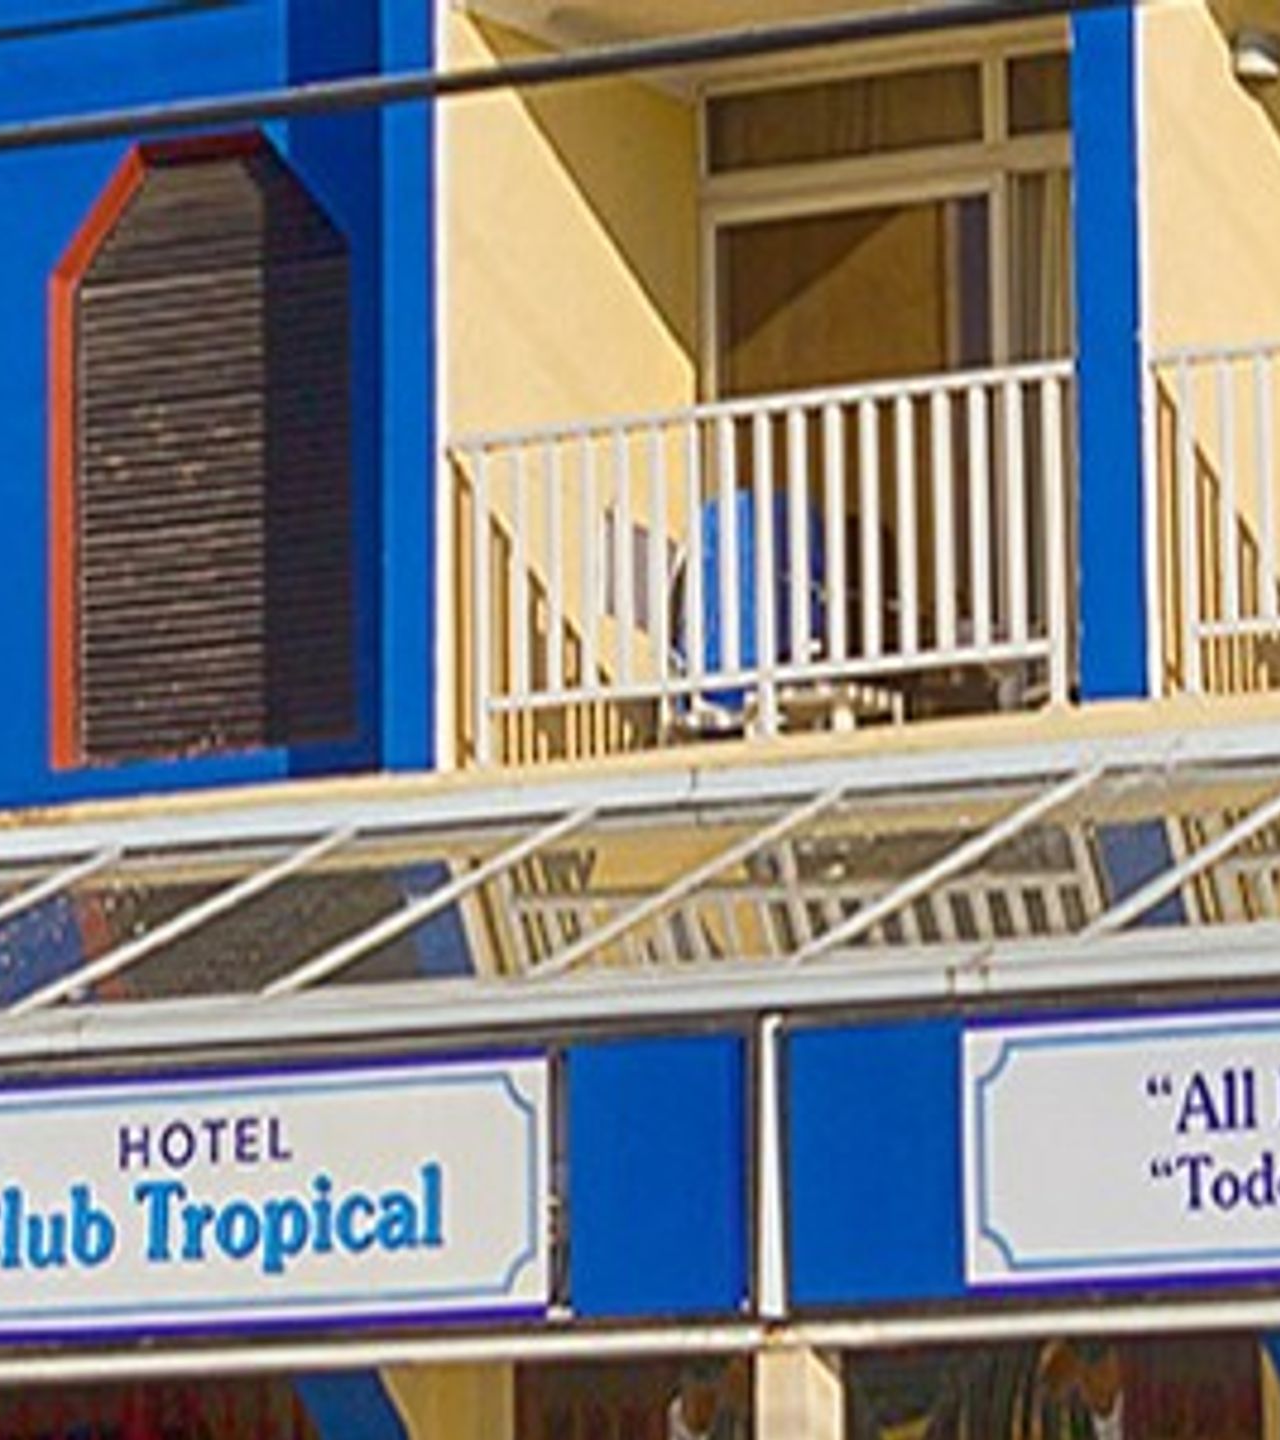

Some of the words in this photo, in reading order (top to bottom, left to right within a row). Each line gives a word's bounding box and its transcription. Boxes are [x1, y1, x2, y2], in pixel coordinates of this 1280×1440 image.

[1145, 1066, 1257, 1134] “All
[118, 1116, 293, 1171] HOTEL
[133, 1161, 444, 1274] Tropical
